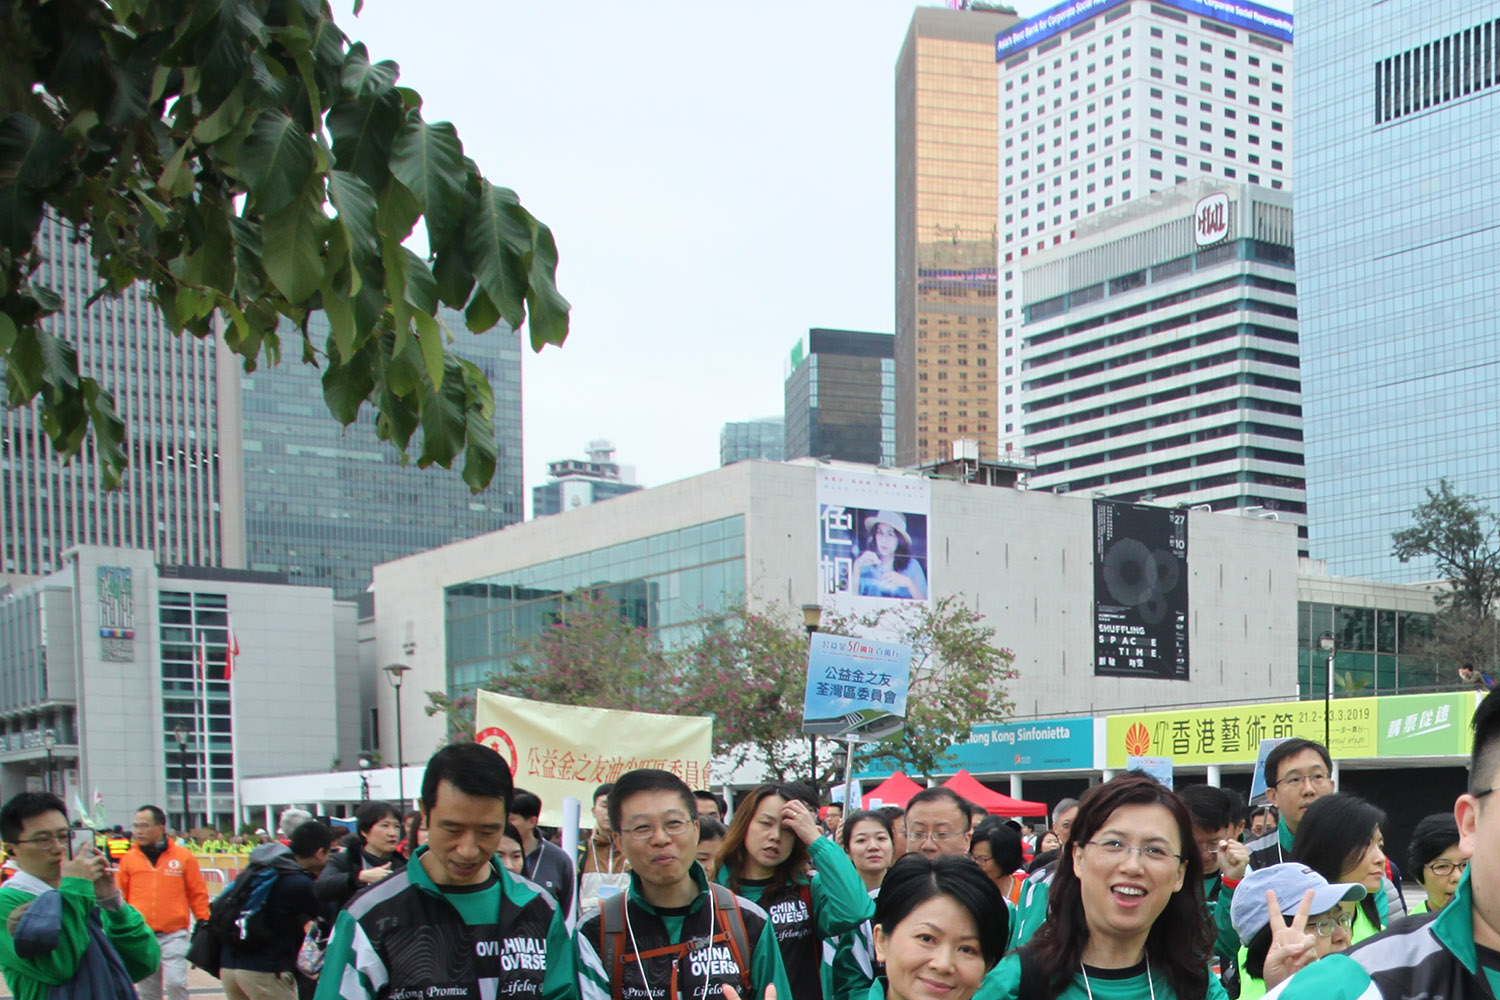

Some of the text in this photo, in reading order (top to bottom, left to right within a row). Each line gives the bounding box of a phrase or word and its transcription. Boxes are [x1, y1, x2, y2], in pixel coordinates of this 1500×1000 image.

[1047, 7, 1076, 29] Corporate
[1235, 5, 1253, 19] Social
[1254, 11, 1293, 33] Responsibility
[1174, 515, 1185, 524] 27
[1175, 540, 1185, 549] 10
[1098, 624, 1145, 635] SHUFFLING
[825, 666, 892, 687] 公益金之友
[816, 682, 896, 704] 荃灣區委員會
[992, 730, 1015, 745] Kong
[1017, 727, 1070, 742] Sinfonietta
[1172, 713, 1293, 756] 香港藝術節
[501, 953, 547, 971] OVERSE
[689, 947, 732, 962] CHINA
